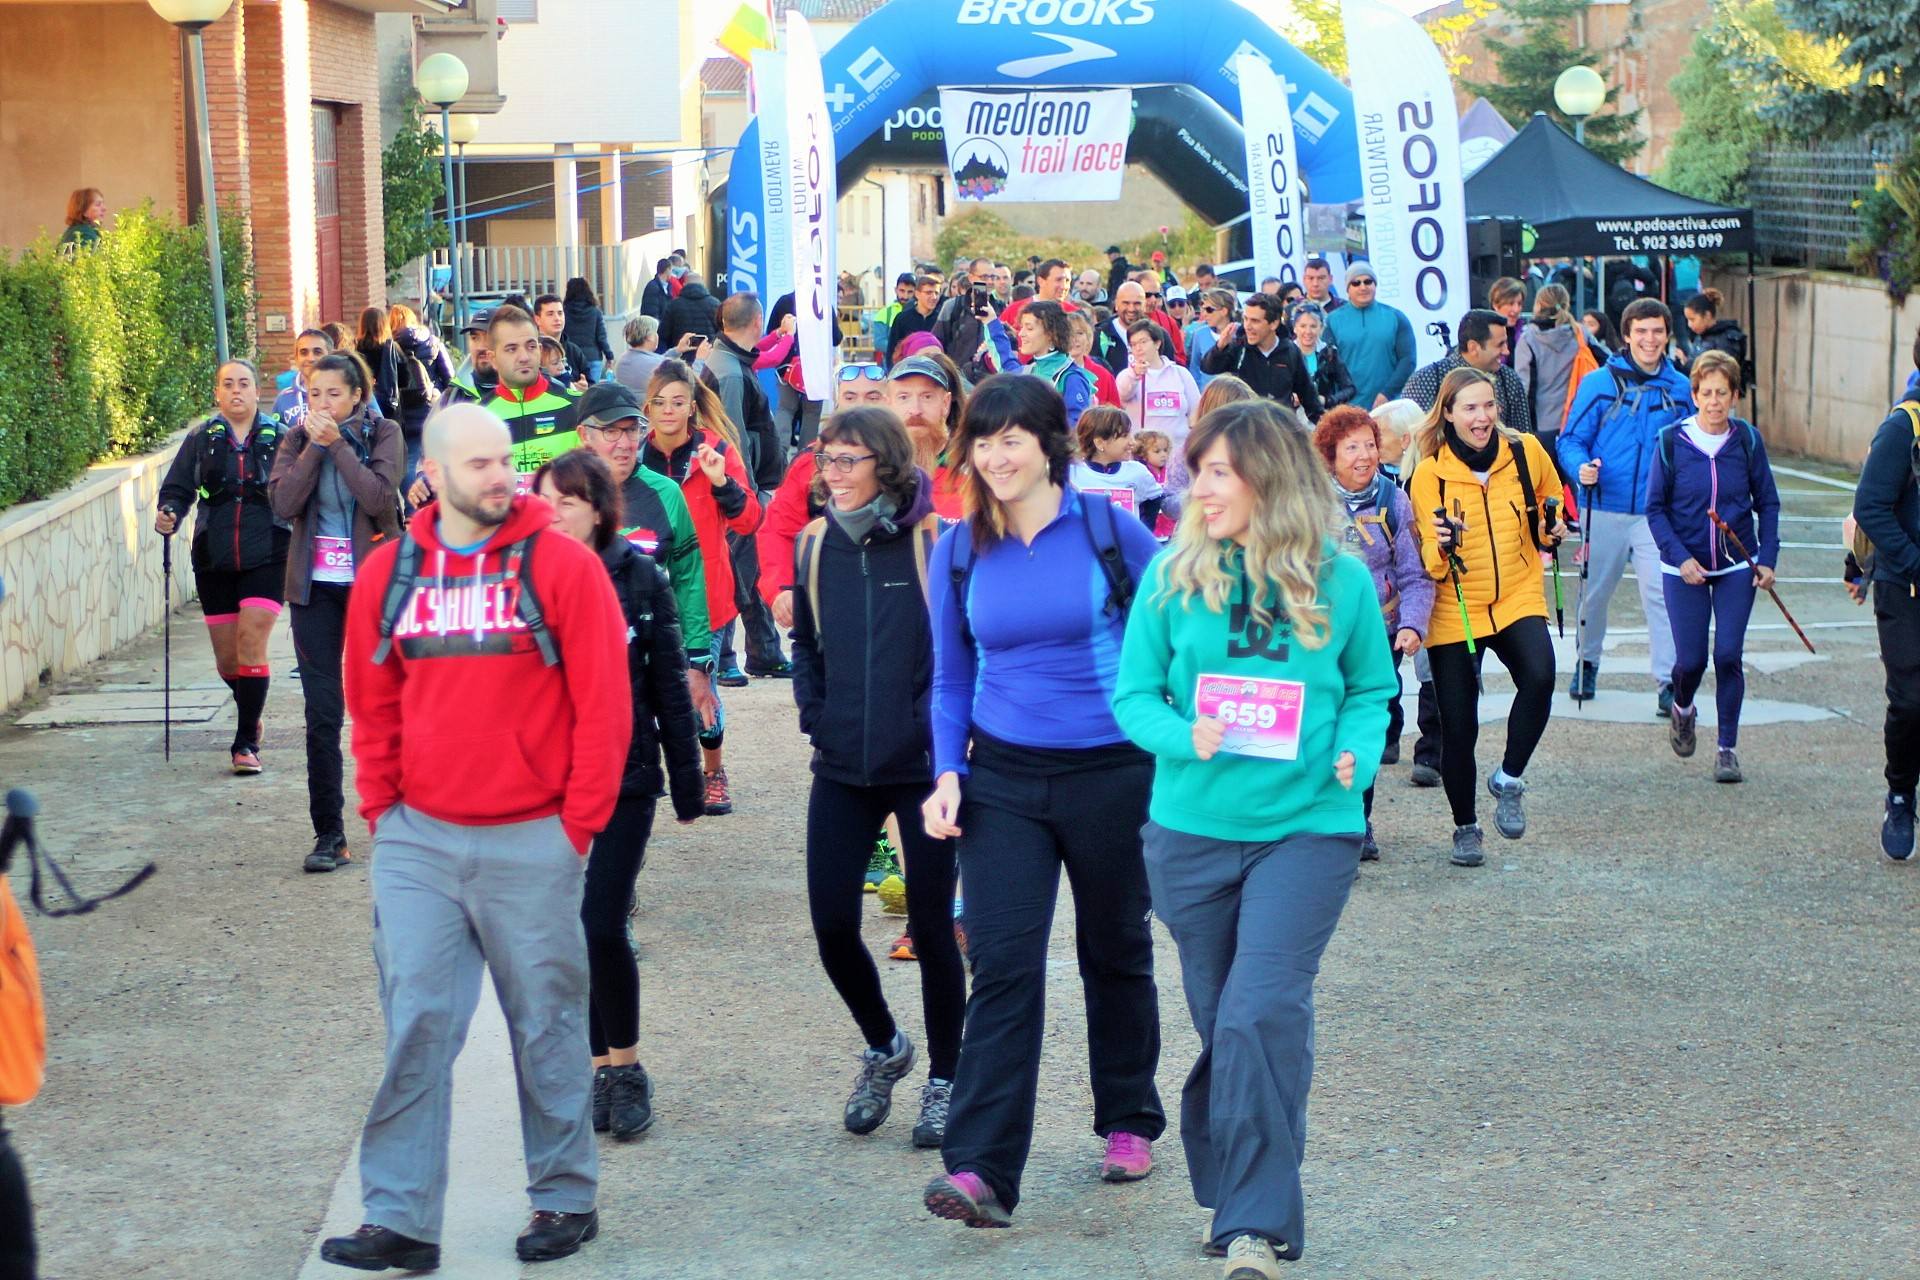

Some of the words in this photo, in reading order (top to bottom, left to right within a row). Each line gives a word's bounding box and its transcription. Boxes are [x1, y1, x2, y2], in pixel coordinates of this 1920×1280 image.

[956, 0, 1154, 26] BROOKS
[966, 92, 1091, 136] medrano
[1020, 137, 1069, 173] trail
[1072, 142, 1123, 172] race
[1595, 215, 1741, 234] www.podoactiva.com
[1613, 236, 1639, 250] Tel.
[1642, 235, 1667, 250] 902
[1670, 234, 1695, 249] 365
[1697, 233, 1723, 248] 099
[1153, 398, 1174, 408] 695
[1218, 700, 1277, 729] 659
